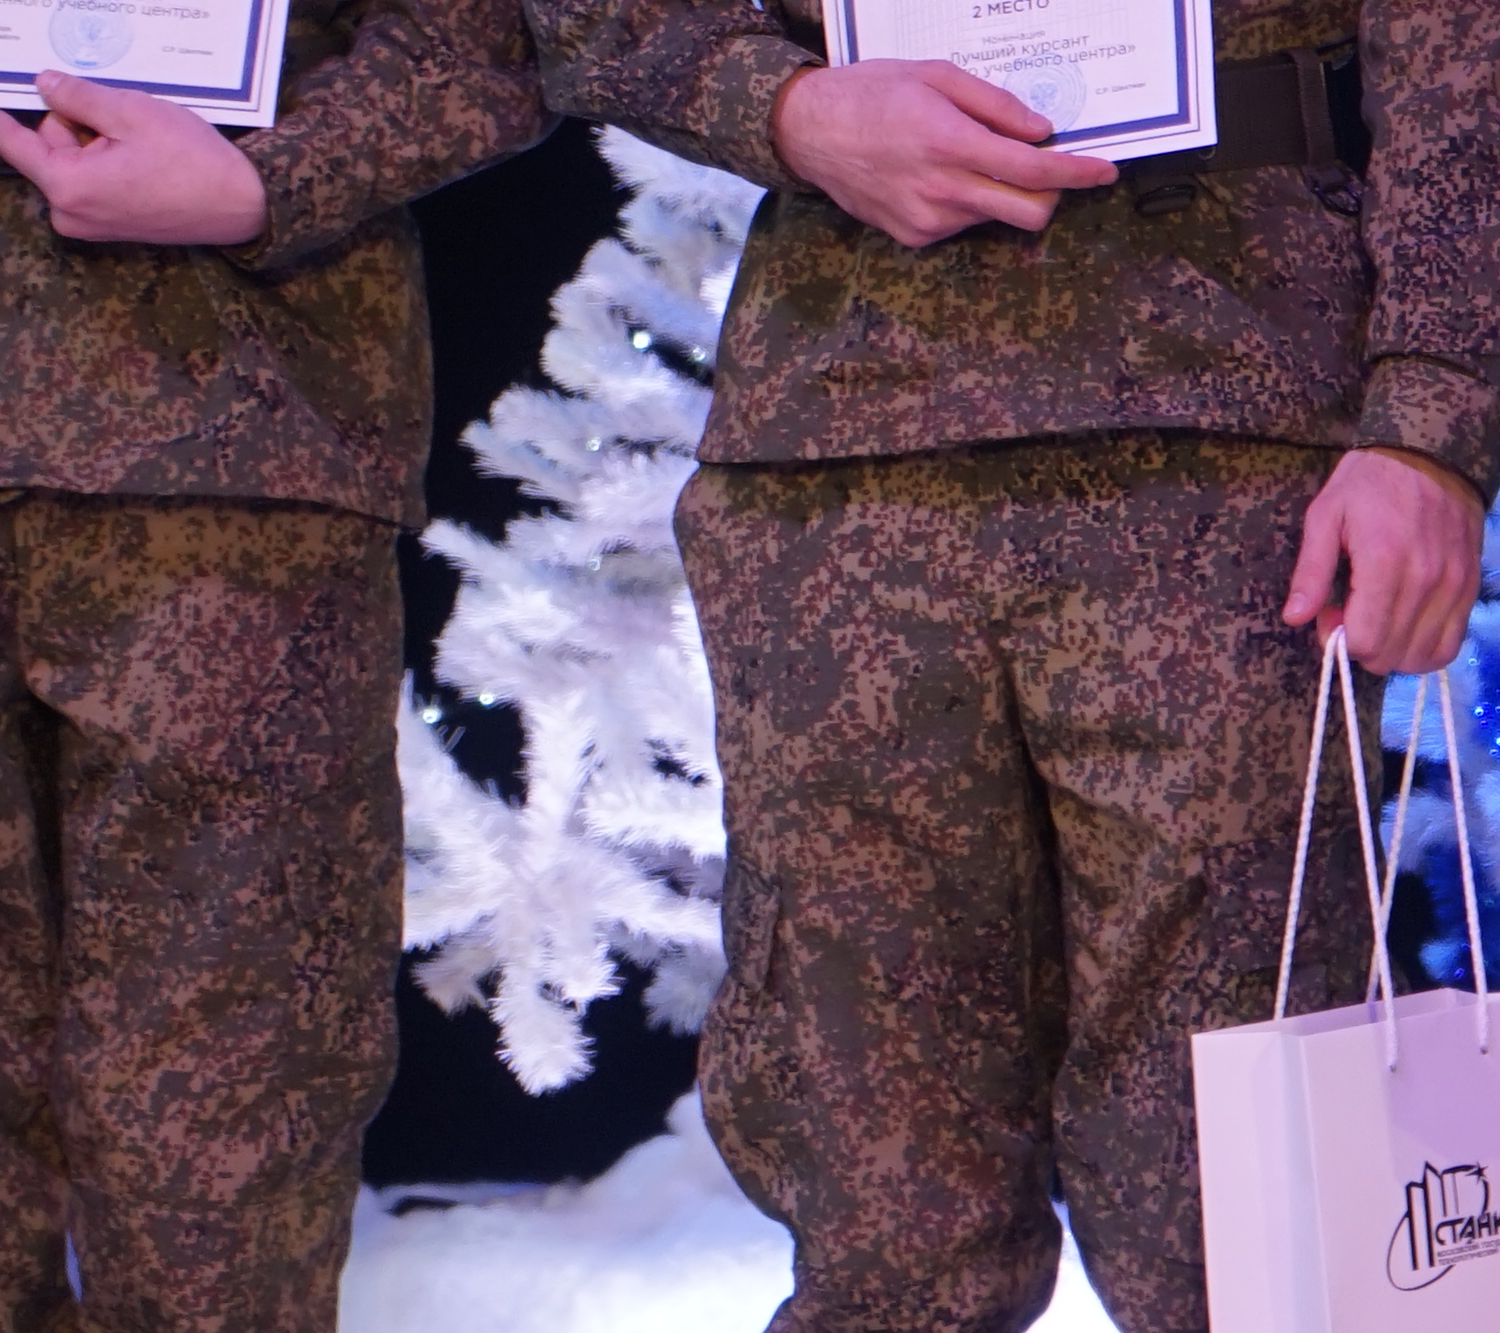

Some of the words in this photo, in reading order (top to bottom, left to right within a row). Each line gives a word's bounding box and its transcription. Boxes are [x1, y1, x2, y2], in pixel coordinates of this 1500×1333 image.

[142, 5, 211, 21] центра»
[972, 5, 984, 19] 2
[951, 44, 1016, 66] Лучший
[1022, 35, 1090, 56] курсант
[984, 55, 1062, 78] учебного
[1068, 44, 1136, 63] центра»
